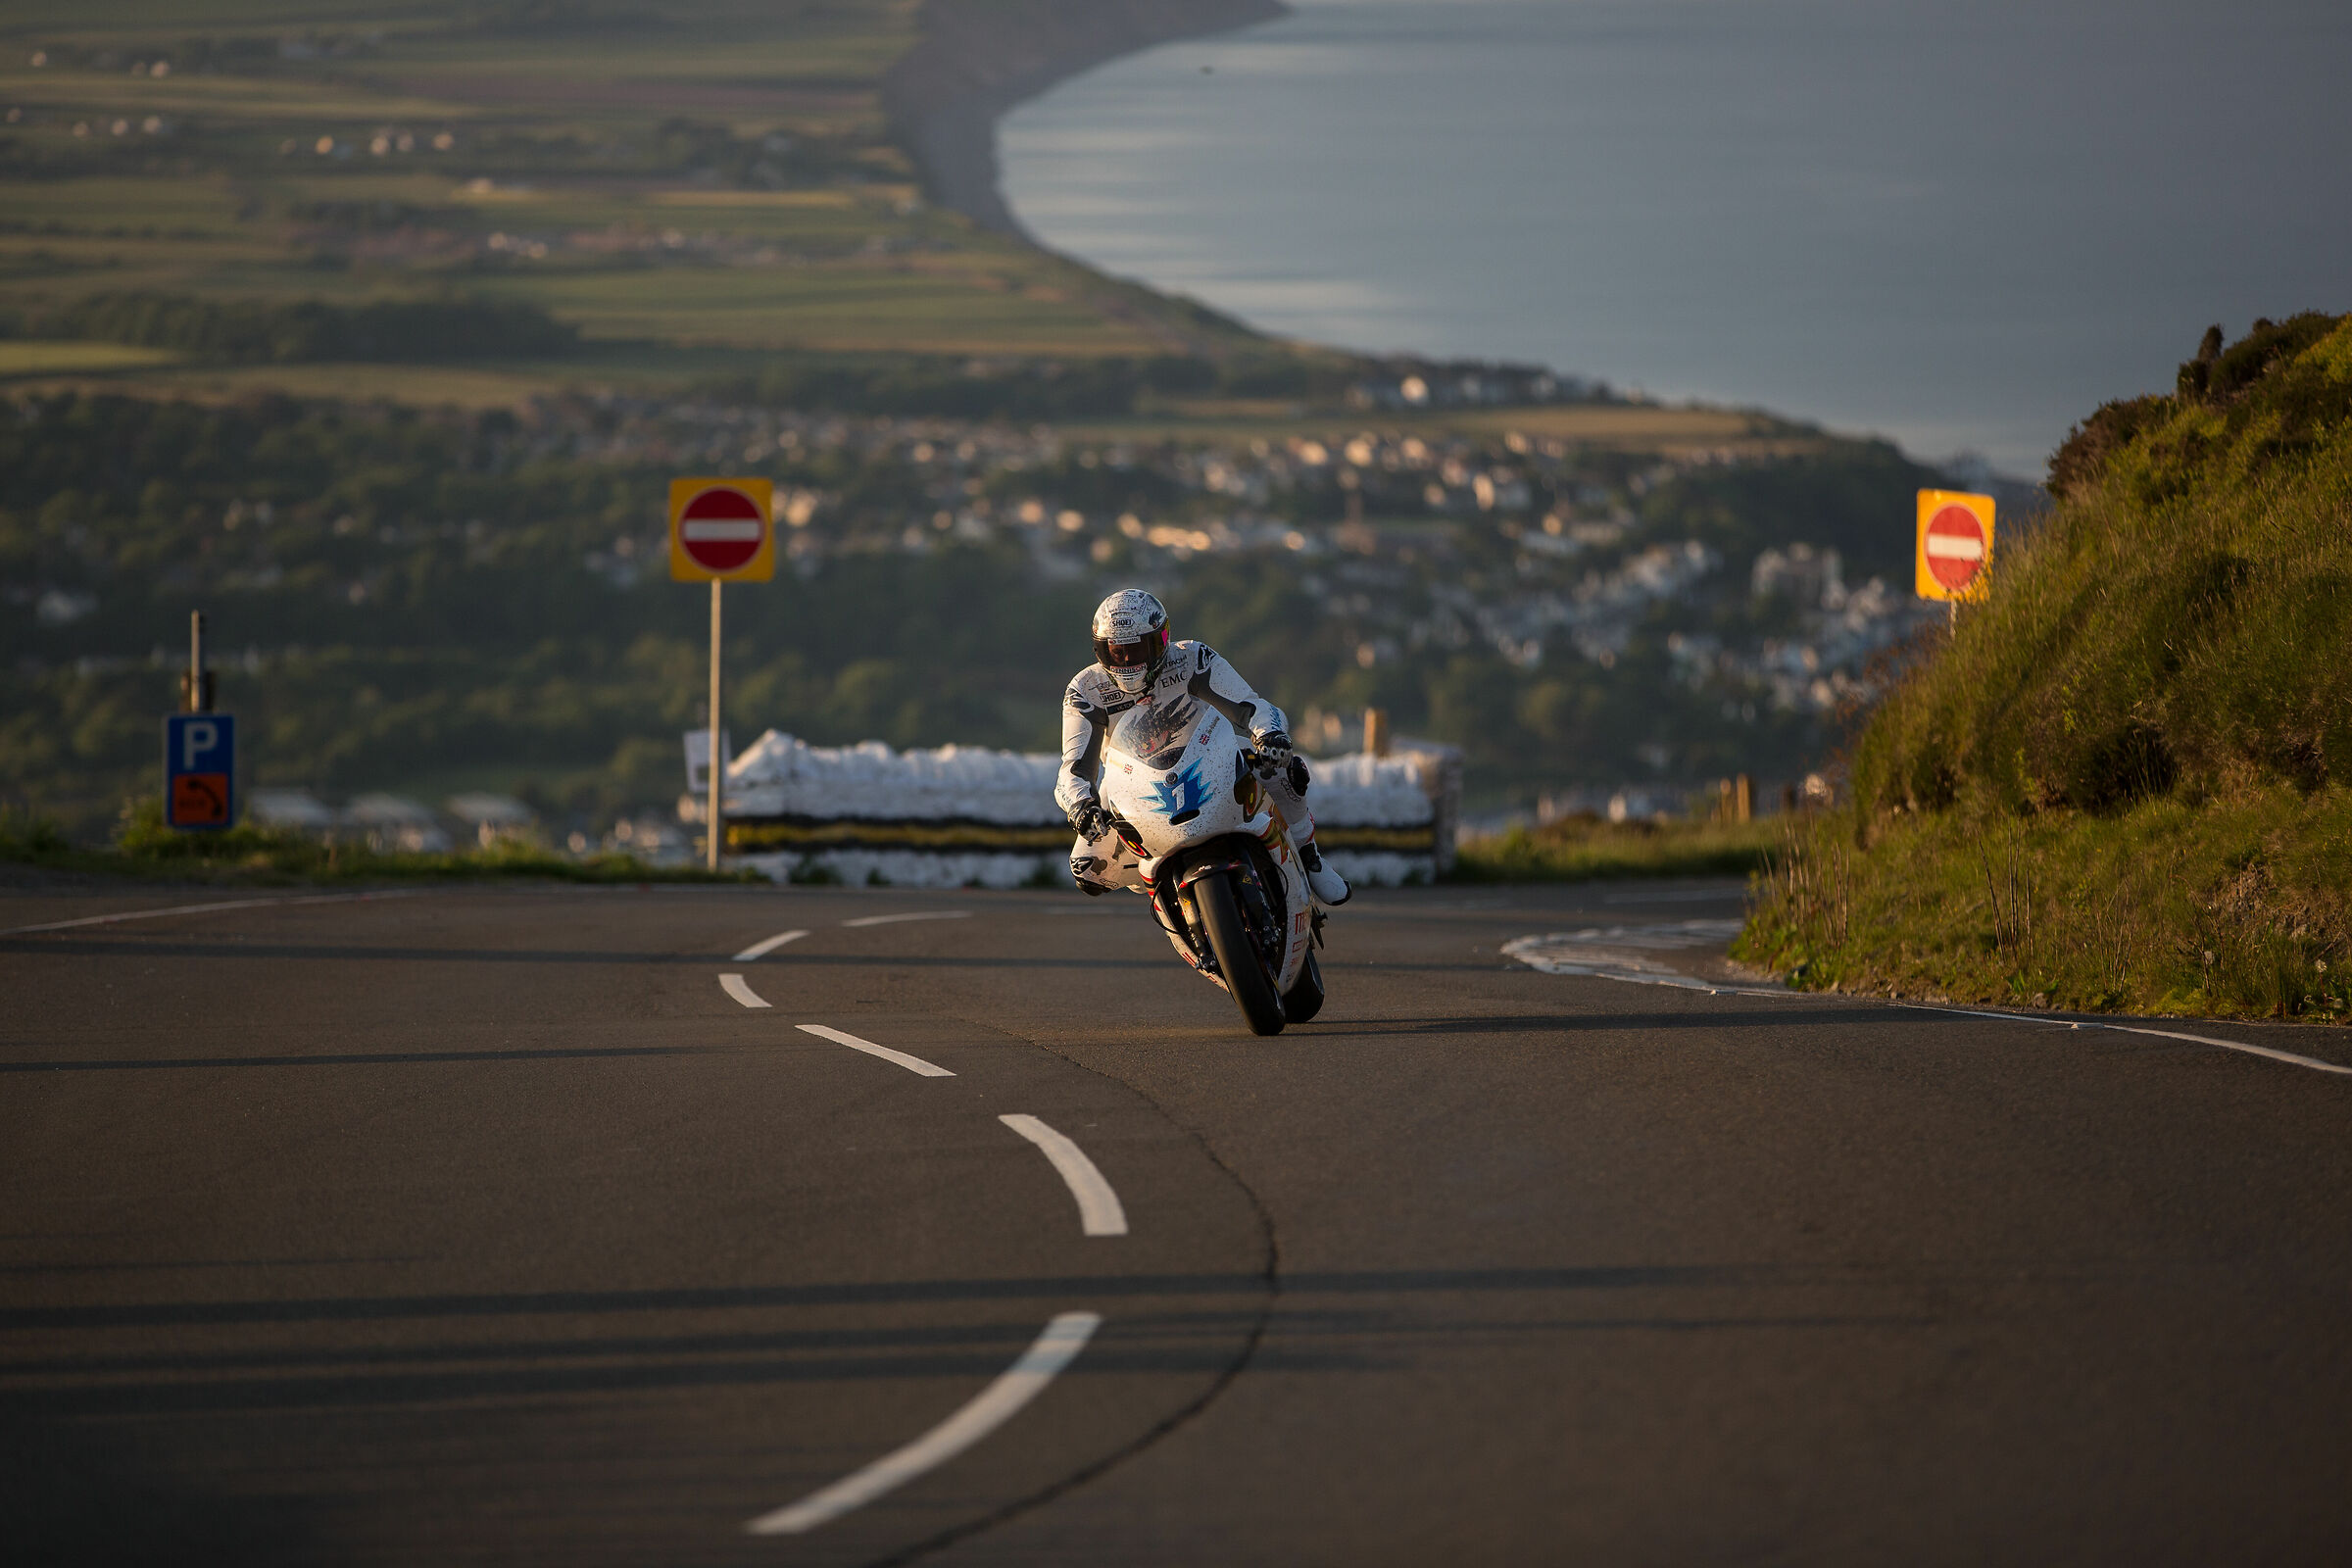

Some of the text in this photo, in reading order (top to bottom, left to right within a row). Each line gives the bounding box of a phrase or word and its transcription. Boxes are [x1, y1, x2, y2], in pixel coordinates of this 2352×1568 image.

[1160, 670, 1188, 688] EMC
[183, 721, 219, 770] P
[1172, 783, 1185, 811] 1
